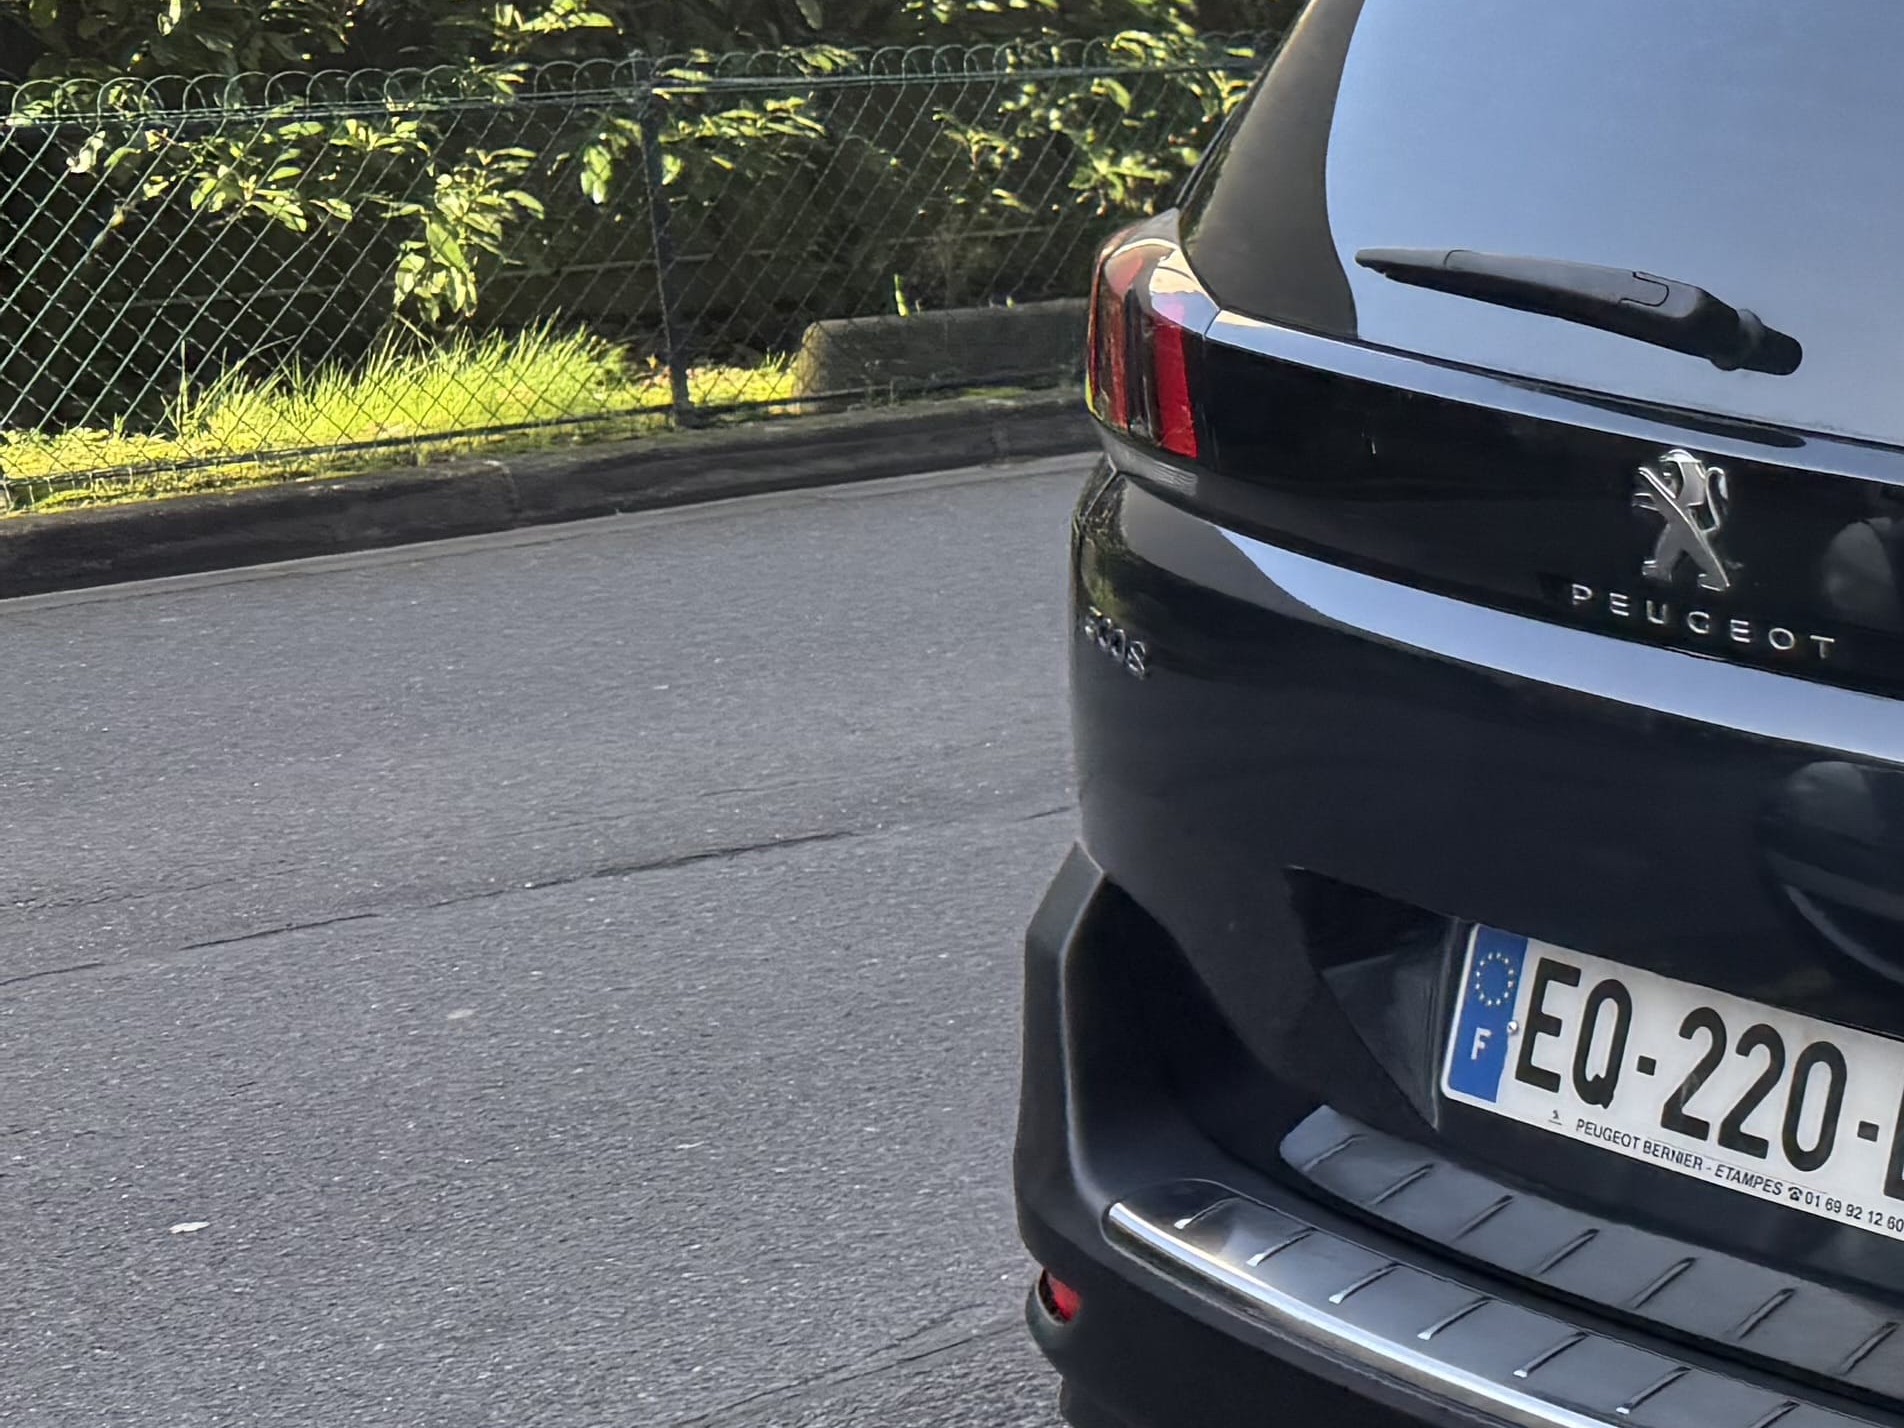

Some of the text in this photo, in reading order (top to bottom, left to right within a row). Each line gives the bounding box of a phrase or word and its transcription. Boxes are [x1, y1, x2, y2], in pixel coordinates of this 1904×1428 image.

[1571, 584, 1835, 658] PEUGEOT
[1470, 1027, 1491, 1061] F
[1575, 1118, 1641, 1149] PEUGEOT
[1643, 1140, 1703, 1171] BERNIER
[1714, 1164, 1784, 1196] ETAMPES
[1825, 1197, 1842, 1214] 69
[1867, 1209, 1884, 1227] 12
